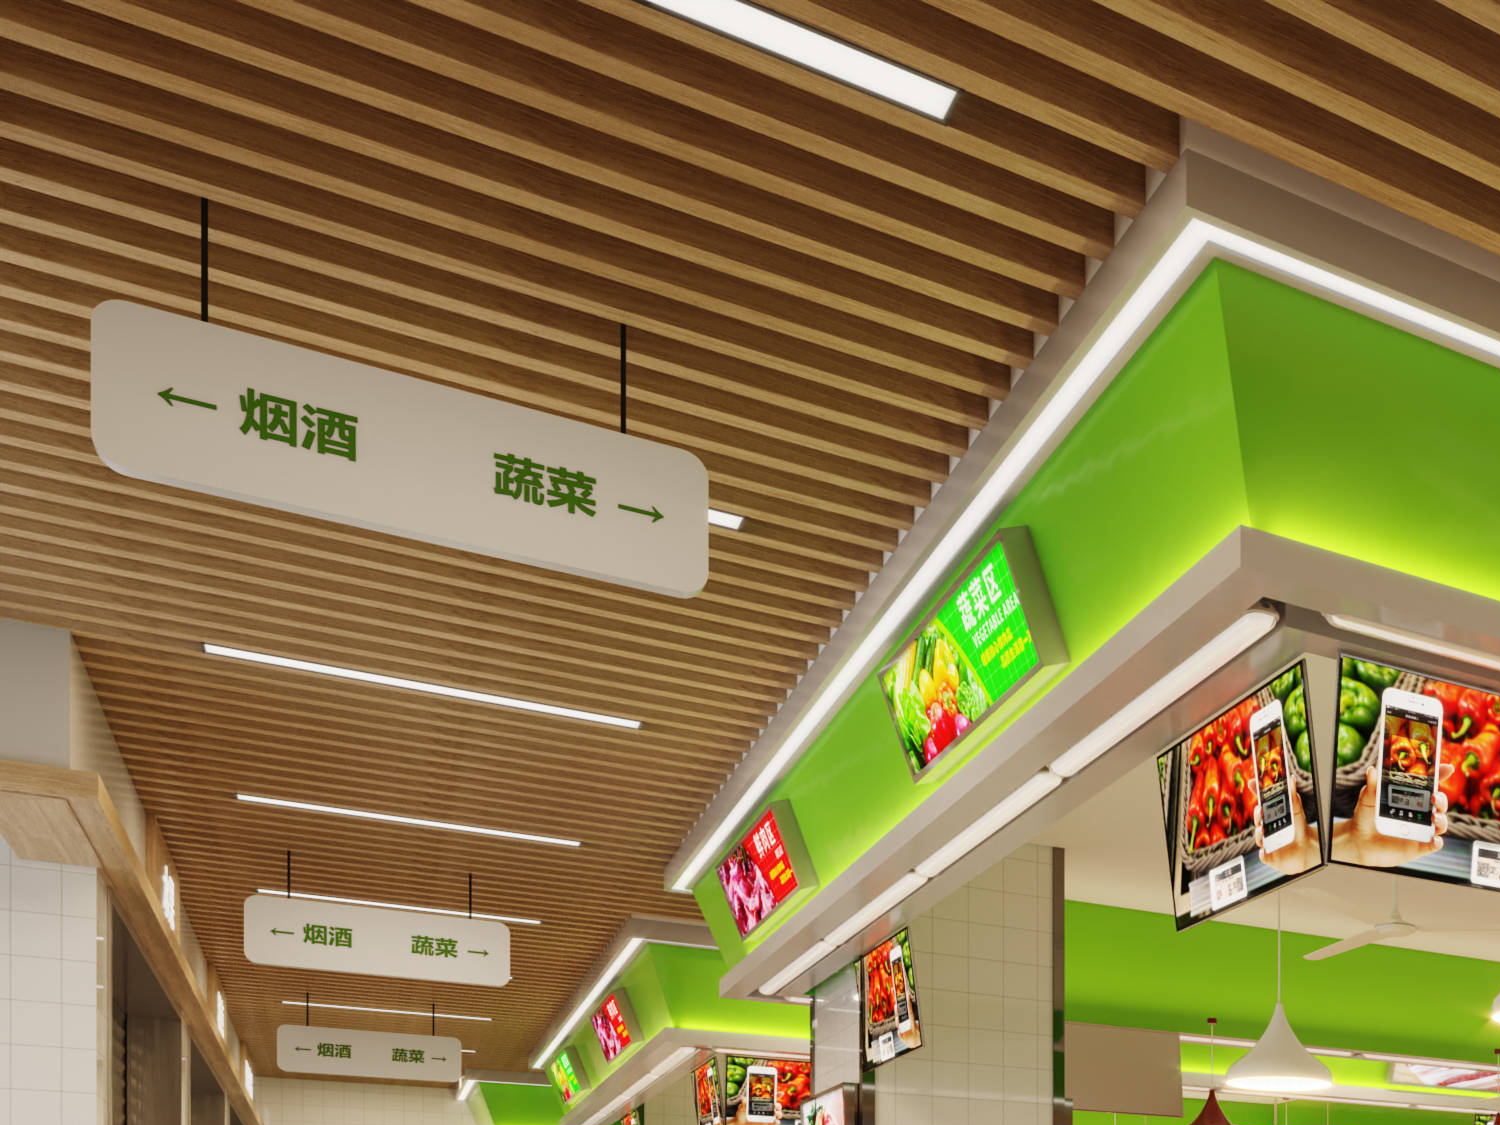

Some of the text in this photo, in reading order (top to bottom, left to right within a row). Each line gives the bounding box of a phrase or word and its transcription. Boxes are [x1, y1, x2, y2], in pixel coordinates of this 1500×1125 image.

[239, 388, 598, 517] 烟酒 蔬菜
[956, 562, 1002, 632] 蔬菜区
[972, 607, 1004, 649] VEGETABLE
[1001, 592, 1021, 619] AREA
[303, 923, 458, 959] 烟酒 蔬菜
[317, 1042, 425, 1064] 烟酒 蔬菜
